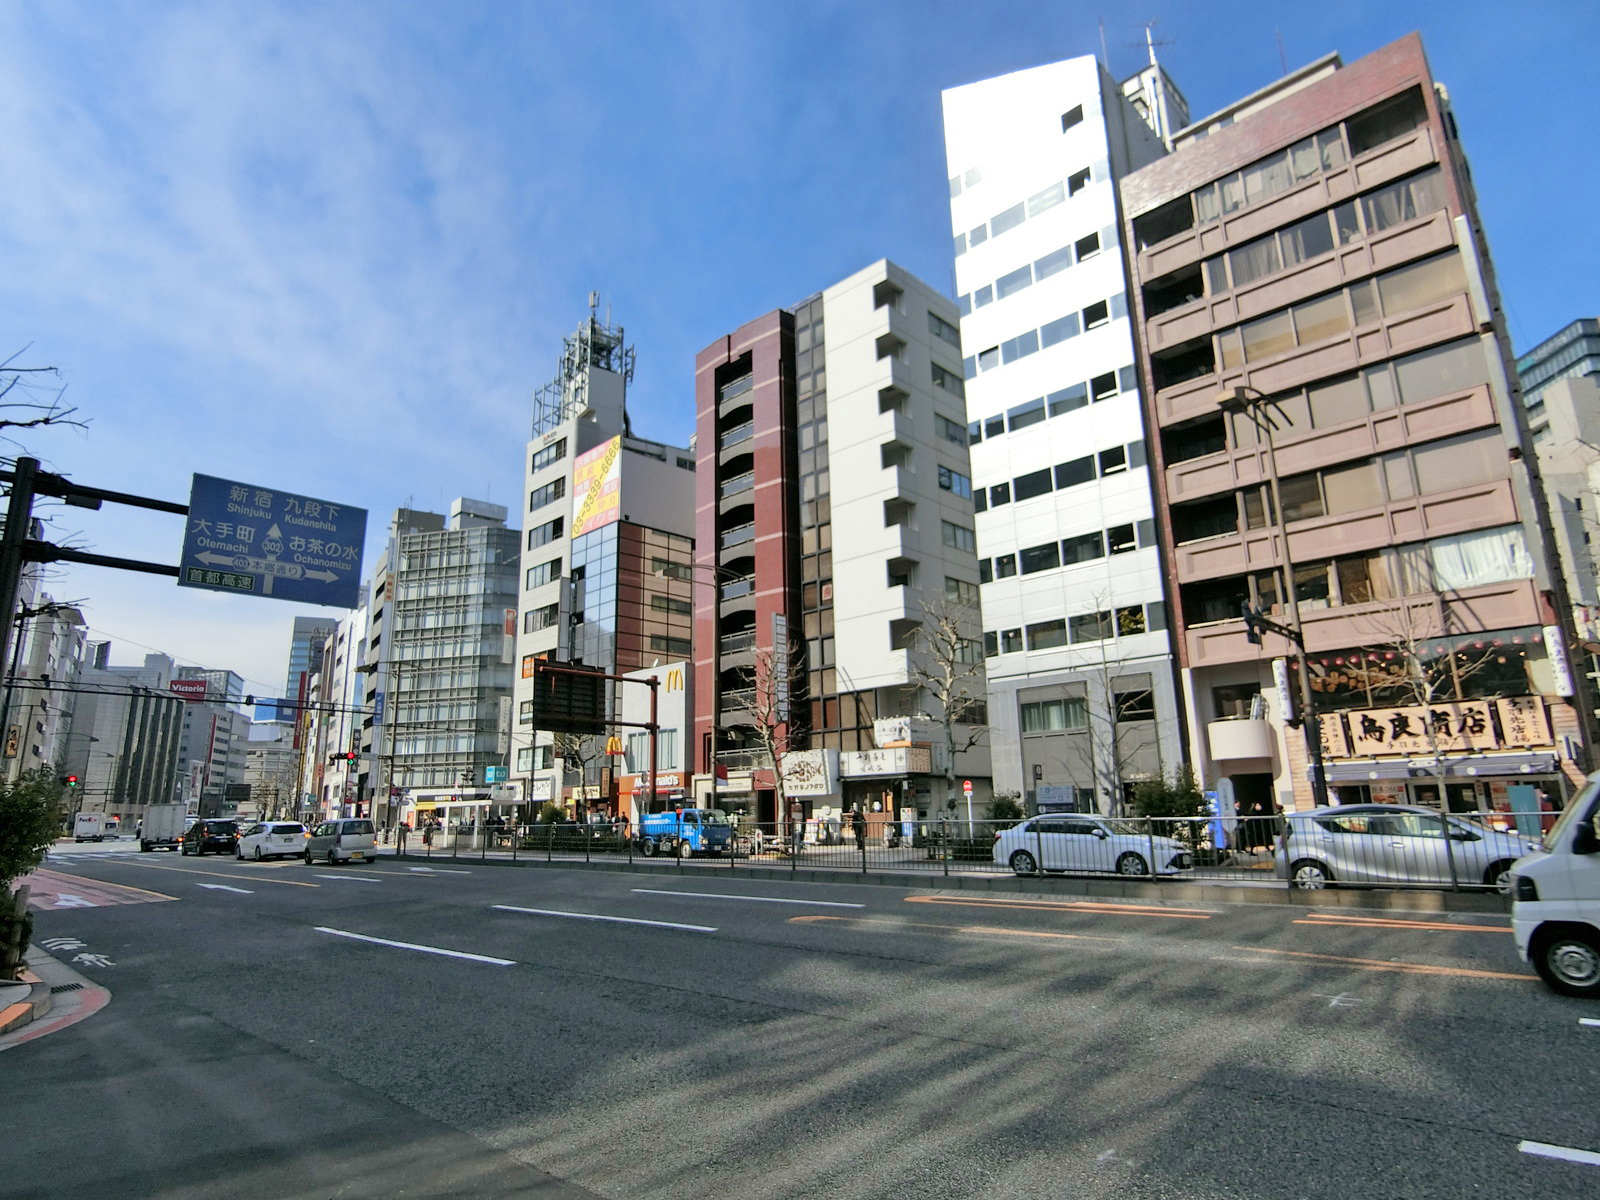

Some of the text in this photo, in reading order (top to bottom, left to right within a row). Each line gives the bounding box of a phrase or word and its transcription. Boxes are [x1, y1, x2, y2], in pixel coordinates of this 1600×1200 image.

[229, 485, 273, 508] 新宿
[573, 440, 620, 534] 03-3339-6666
[227, 502, 272, 519] Shinjuku
[284, 496, 341, 520] 九段下
[191, 518, 255, 543] 大手町
[284, 513, 337, 532] Kudanshita
[196, 536, 249, 554] Otemachi
[263, 541, 281, 552] 302
[289, 535, 359, 561] お茶の水
[233, 558, 248, 568] 403
[251, 560, 299, 576] 本郷通り
[293, 553, 352, 571] Ochanomizu
[189, 568, 253, 589] 首都高速
[172, 684, 205, 692] Victoria
[1357, 707, 1487, 743] 鳥良商店
